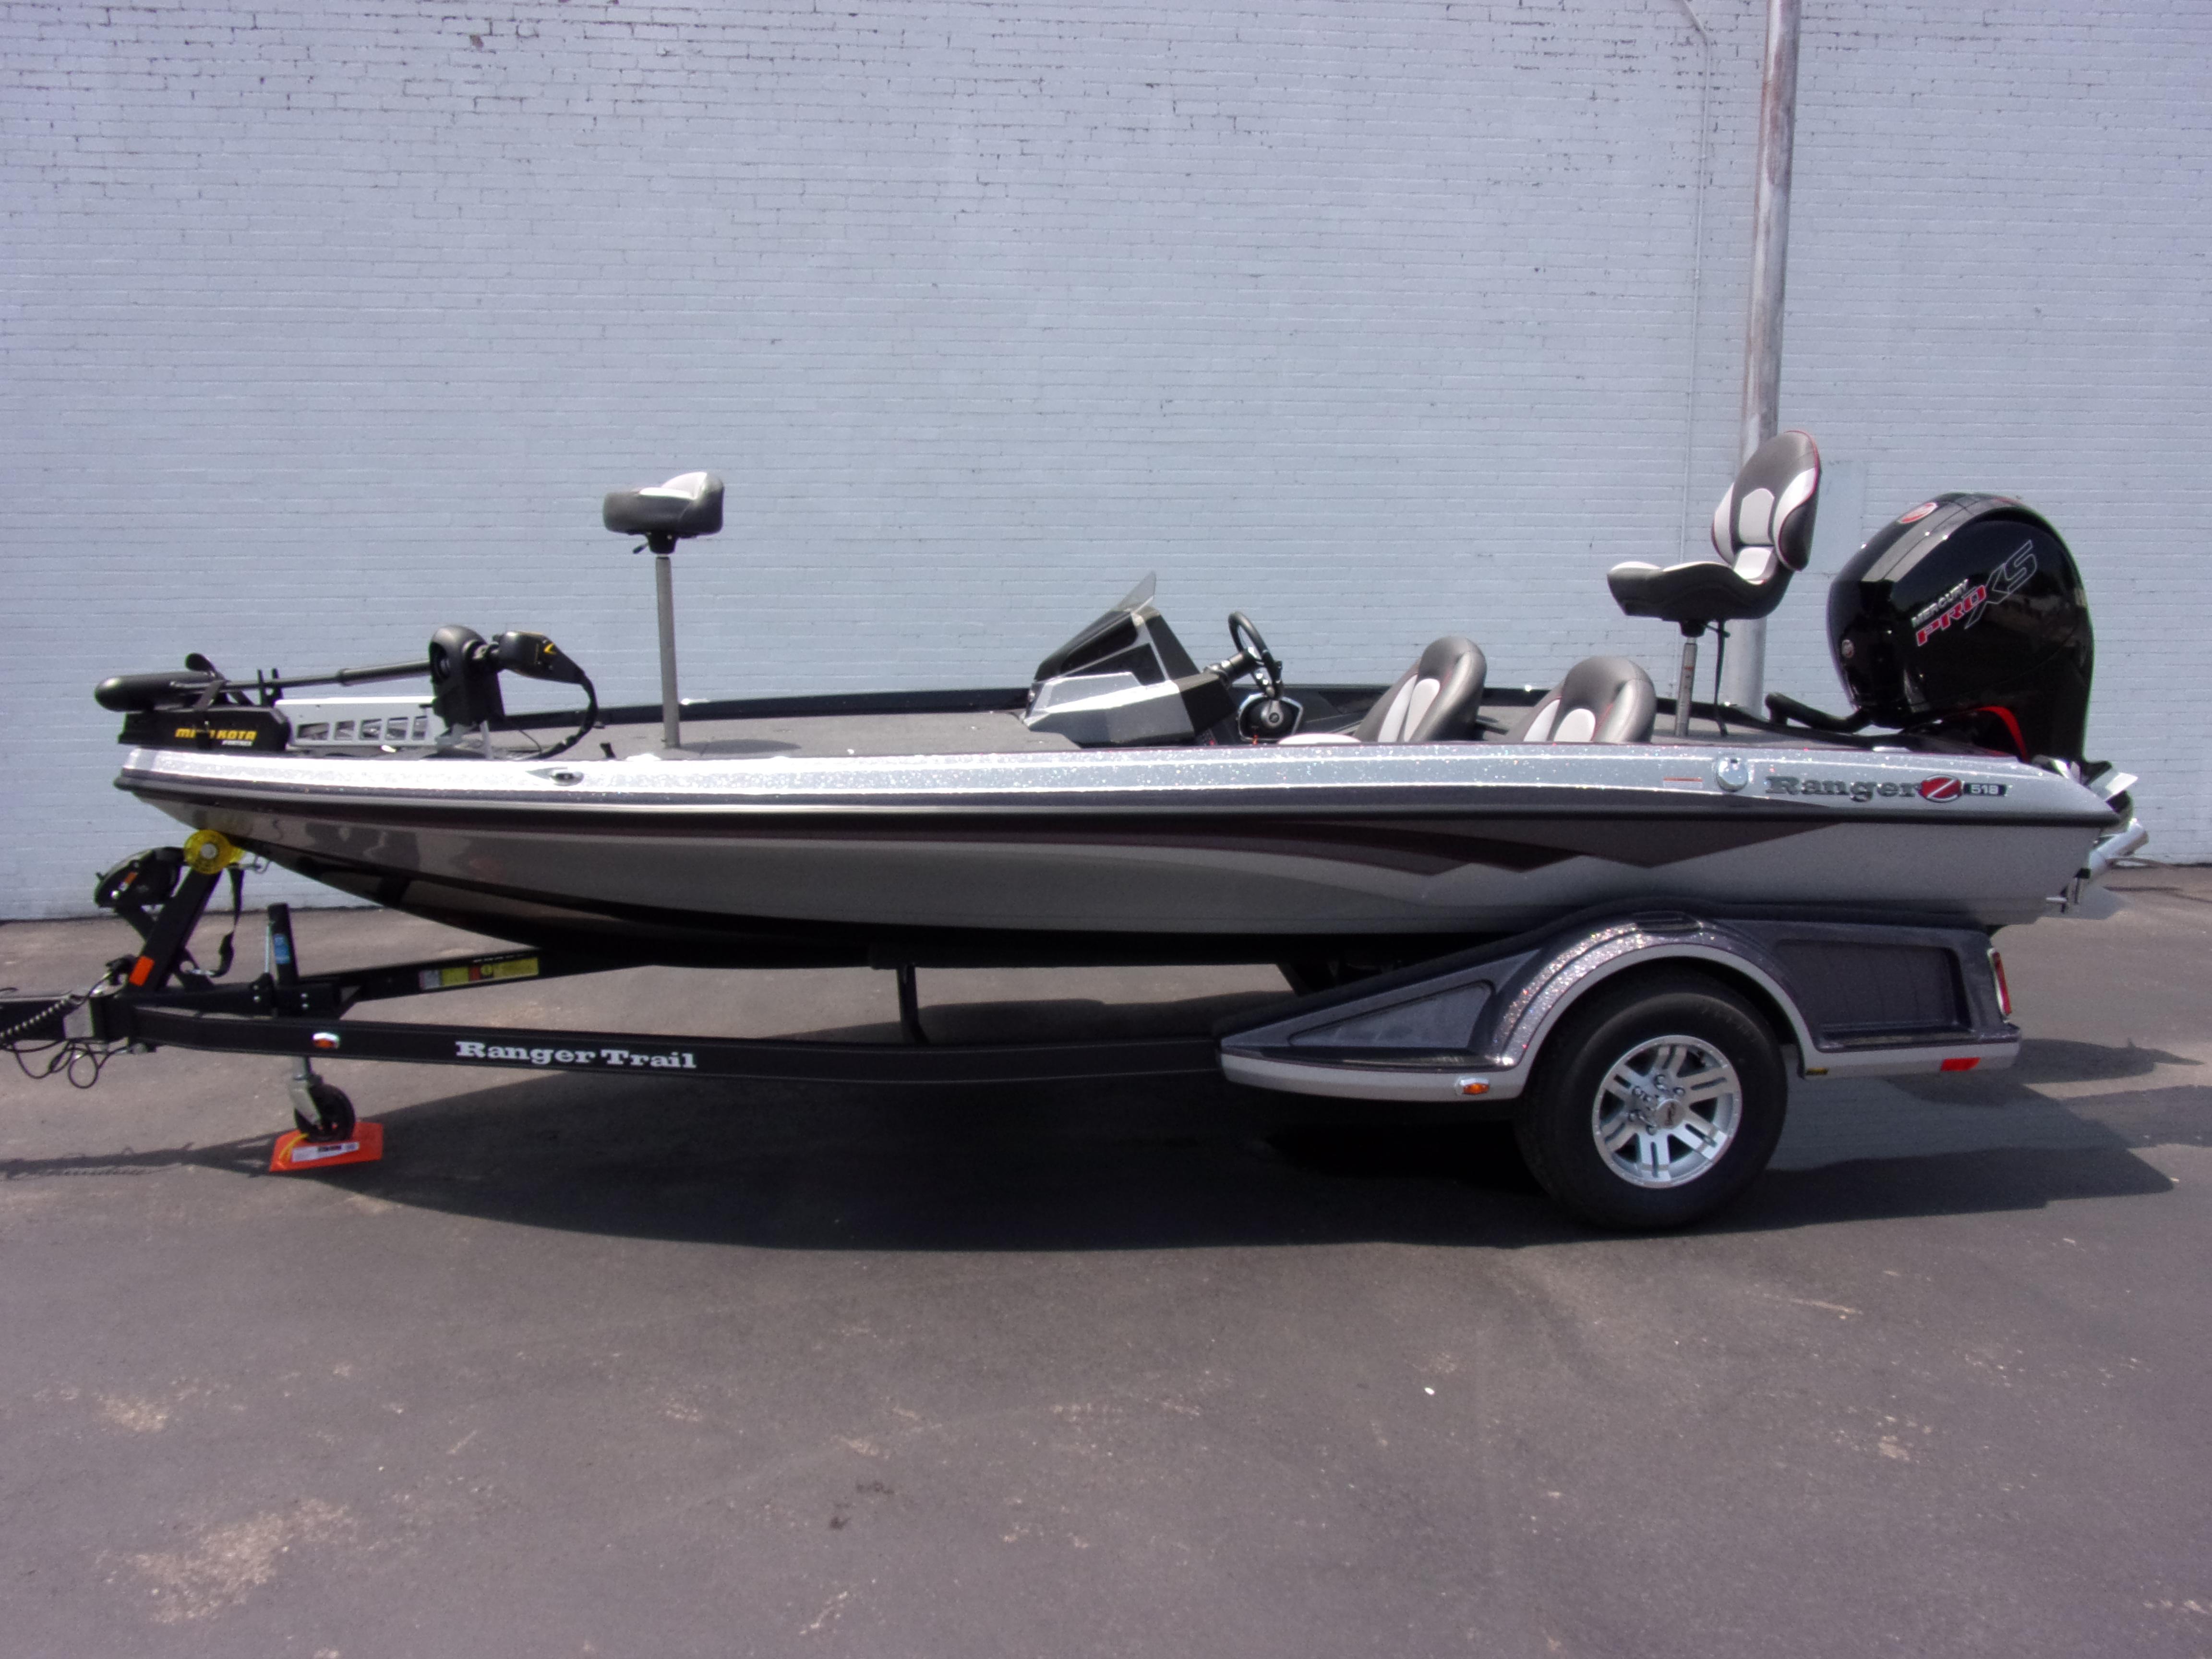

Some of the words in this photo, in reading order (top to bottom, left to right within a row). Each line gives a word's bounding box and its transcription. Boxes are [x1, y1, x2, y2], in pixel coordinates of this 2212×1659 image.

[1911, 578, 1969, 628] MERCURY
[1916, 584, 1987, 646] PRO
[1964, 539, 2038, 630] XS
[216, 729, 257, 741] KOTA
[1765, 775, 1921, 802] Ranger
[1971, 784, 1999, 795] 518
[455, 1041, 595, 1065] Ranger
[601, 1049, 697, 1069] Trail
